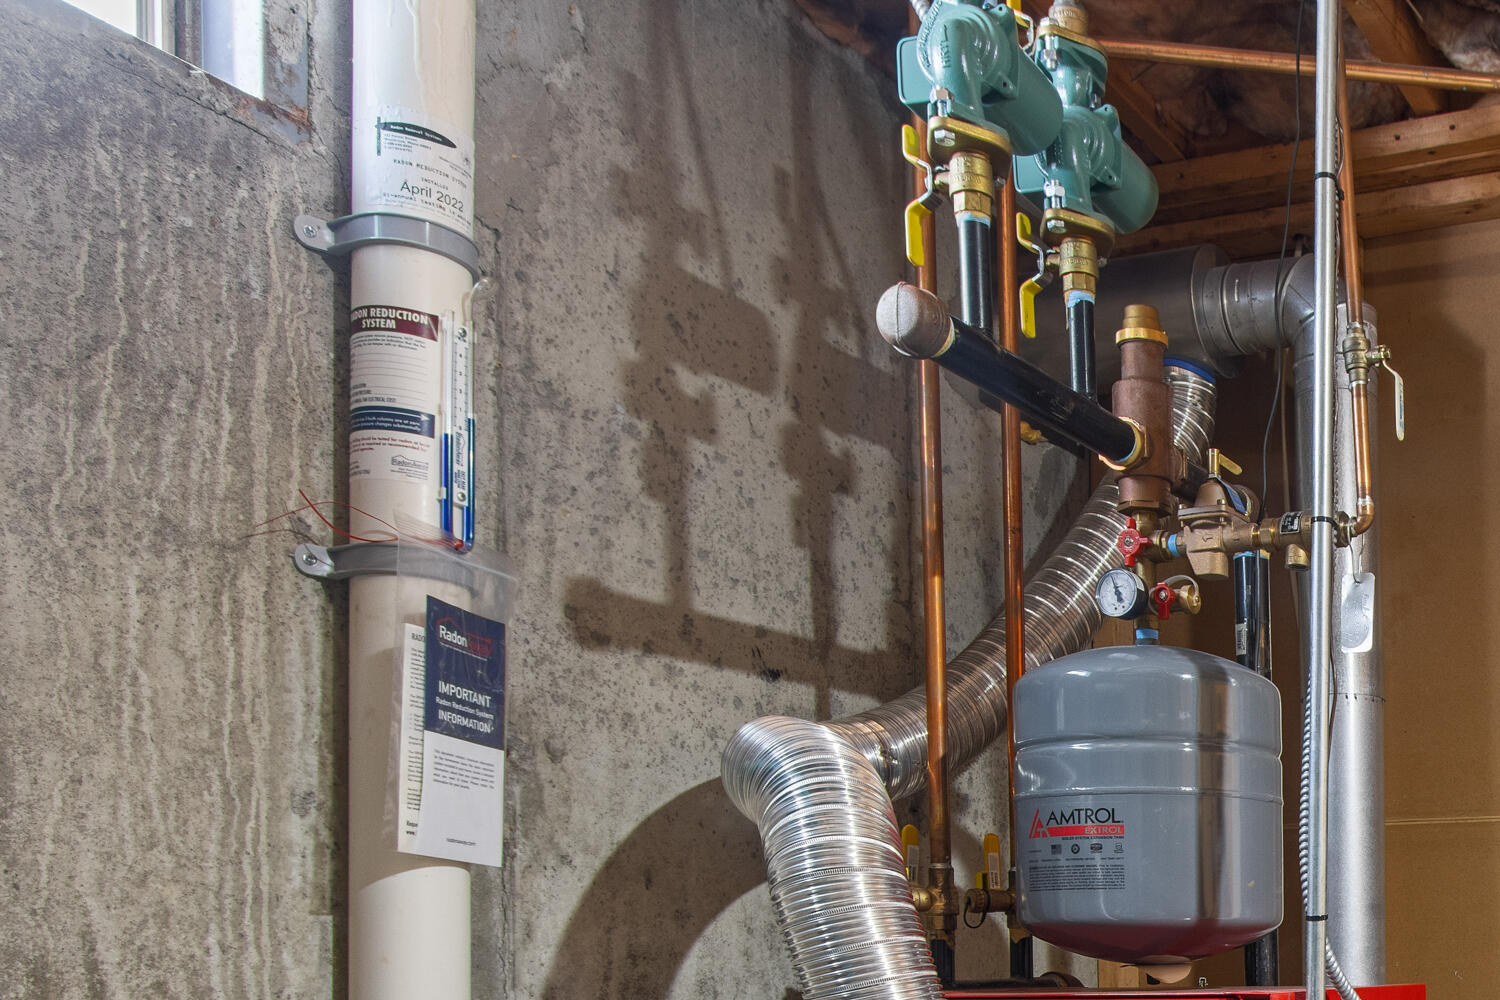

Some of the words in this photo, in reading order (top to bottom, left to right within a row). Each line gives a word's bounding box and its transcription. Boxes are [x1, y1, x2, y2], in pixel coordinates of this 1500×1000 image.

[400, 180, 432, 198] April
[436, 190, 465, 213] 2022
[362, 319, 396, 329] SYSTEM
[369, 307, 429, 326] REDUCTION
[439, 680, 492, 708] IMPORTANT
[435, 696, 452, 708] Radon
[452, 700, 475, 715] Reduction
[475, 707, 494, 720] System
[438, 709, 491, 734] INFORMATION
[1046, 807, 1121, 826] AMTROL
[1084, 826, 1123, 834] EXTROL
